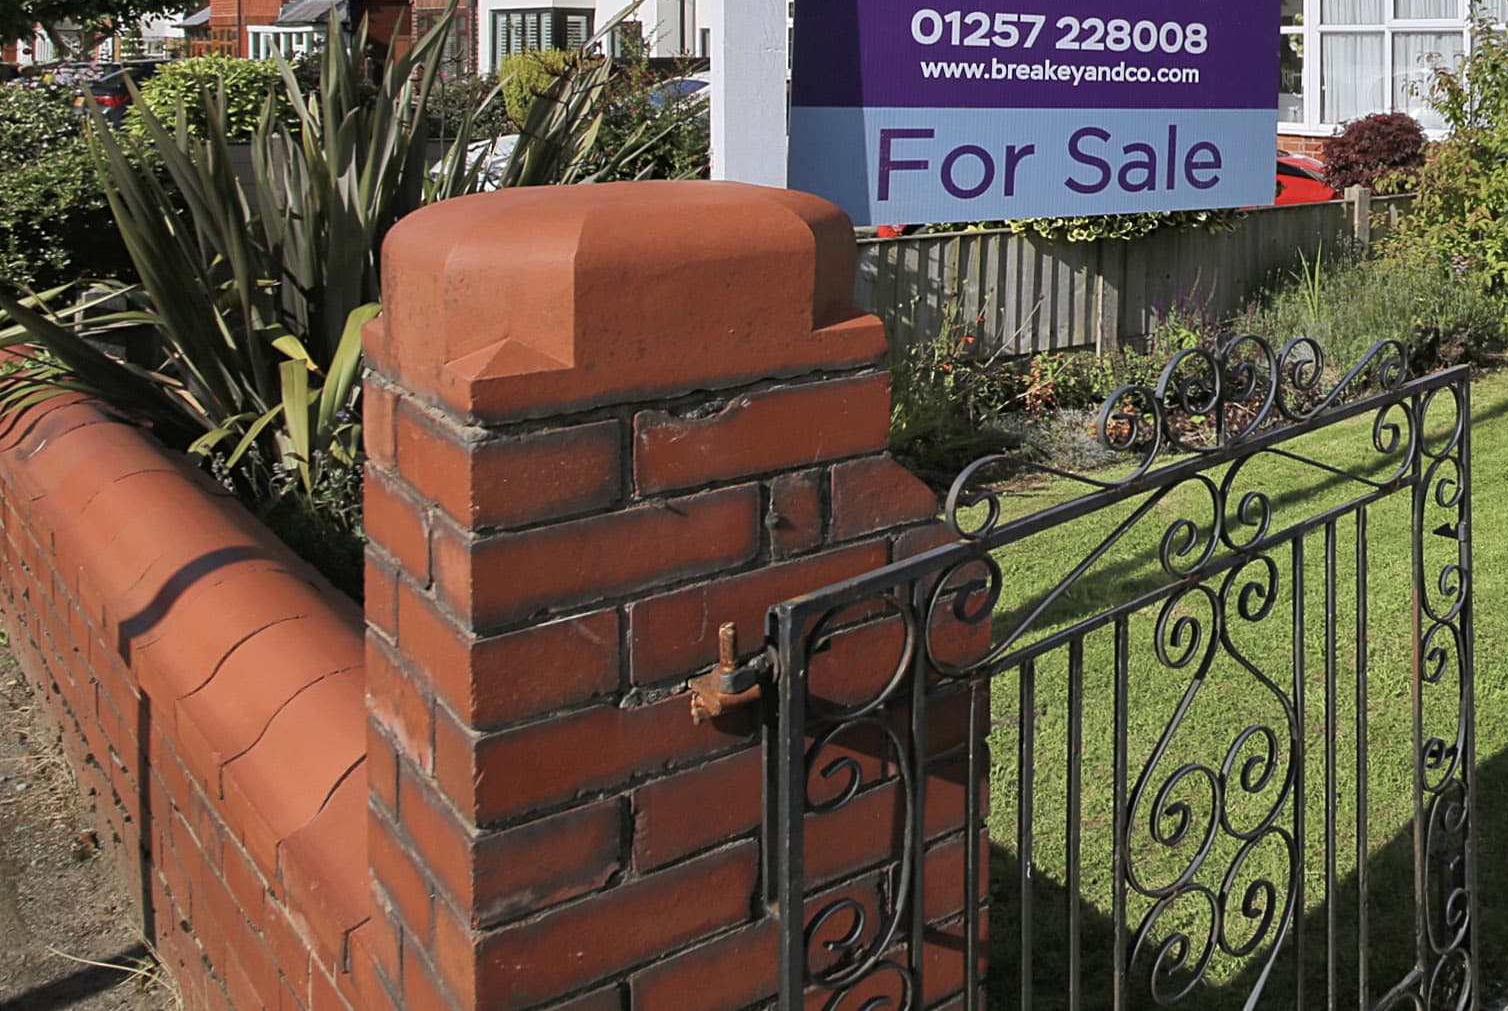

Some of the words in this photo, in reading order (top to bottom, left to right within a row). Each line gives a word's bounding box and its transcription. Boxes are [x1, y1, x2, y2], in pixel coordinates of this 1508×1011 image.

[910, 7, 1047, 49] 01257
[1054, 15, 1209, 55] 228008
[919, 57, 1201, 87] www.breakeyandco.com
[876, 127, 1036, 203] For
[1063, 123, 1223, 196] Sale
